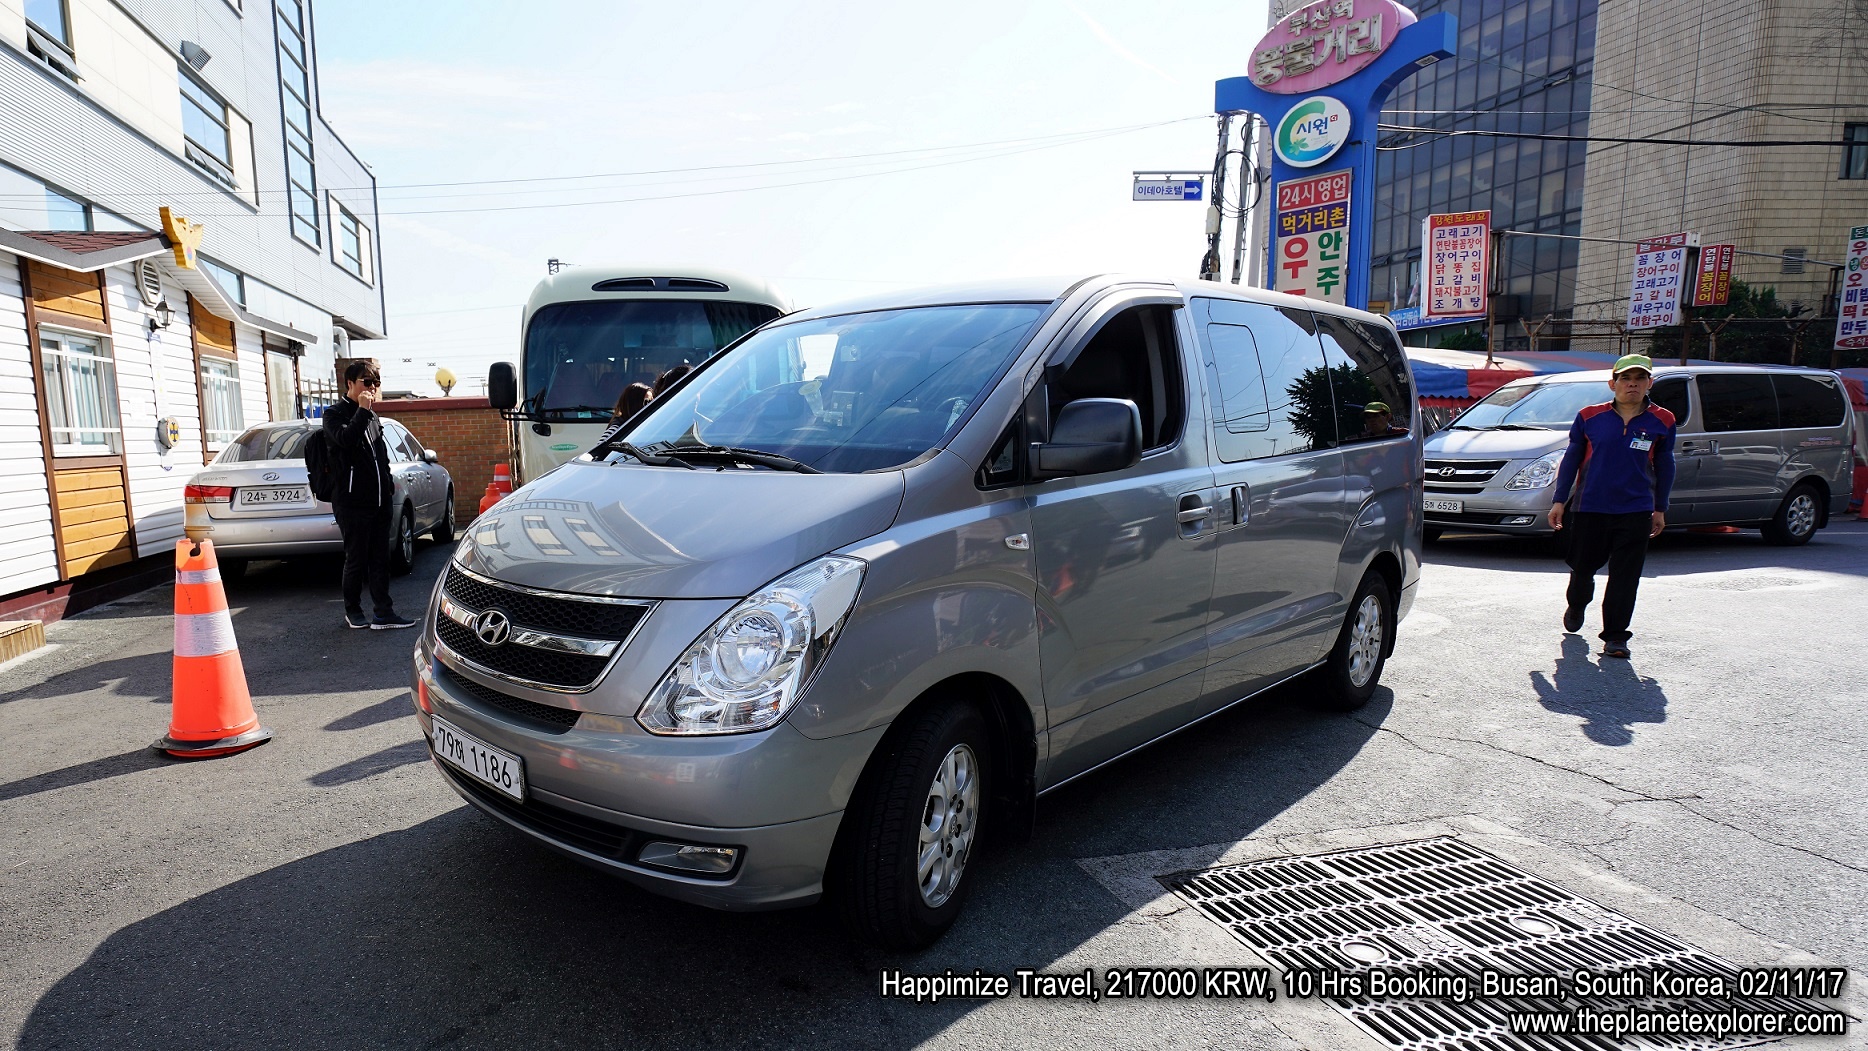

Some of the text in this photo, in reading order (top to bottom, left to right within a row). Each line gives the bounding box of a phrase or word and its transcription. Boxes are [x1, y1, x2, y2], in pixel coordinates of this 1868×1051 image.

[1296, 117, 1328, 135] 시원
[1137, 185, 1183, 195] 이데아호텔
[1282, 207, 1345, 234] 먹거리촌
[1436, 226, 1482, 239] 고래고기
[1435, 250, 1481, 263] 장어구이
[1637, 262, 1680, 278] 장어구이
[1635, 275, 1678, 289] 고래고기
[1632, 301, 1675, 314] 새우구이
[1630, 313, 1673, 326] 대합구이
[272, 490, 300, 501] 3924
[1437, 501, 1458, 511] 6528
[470, 745, 512, 789] 1186
